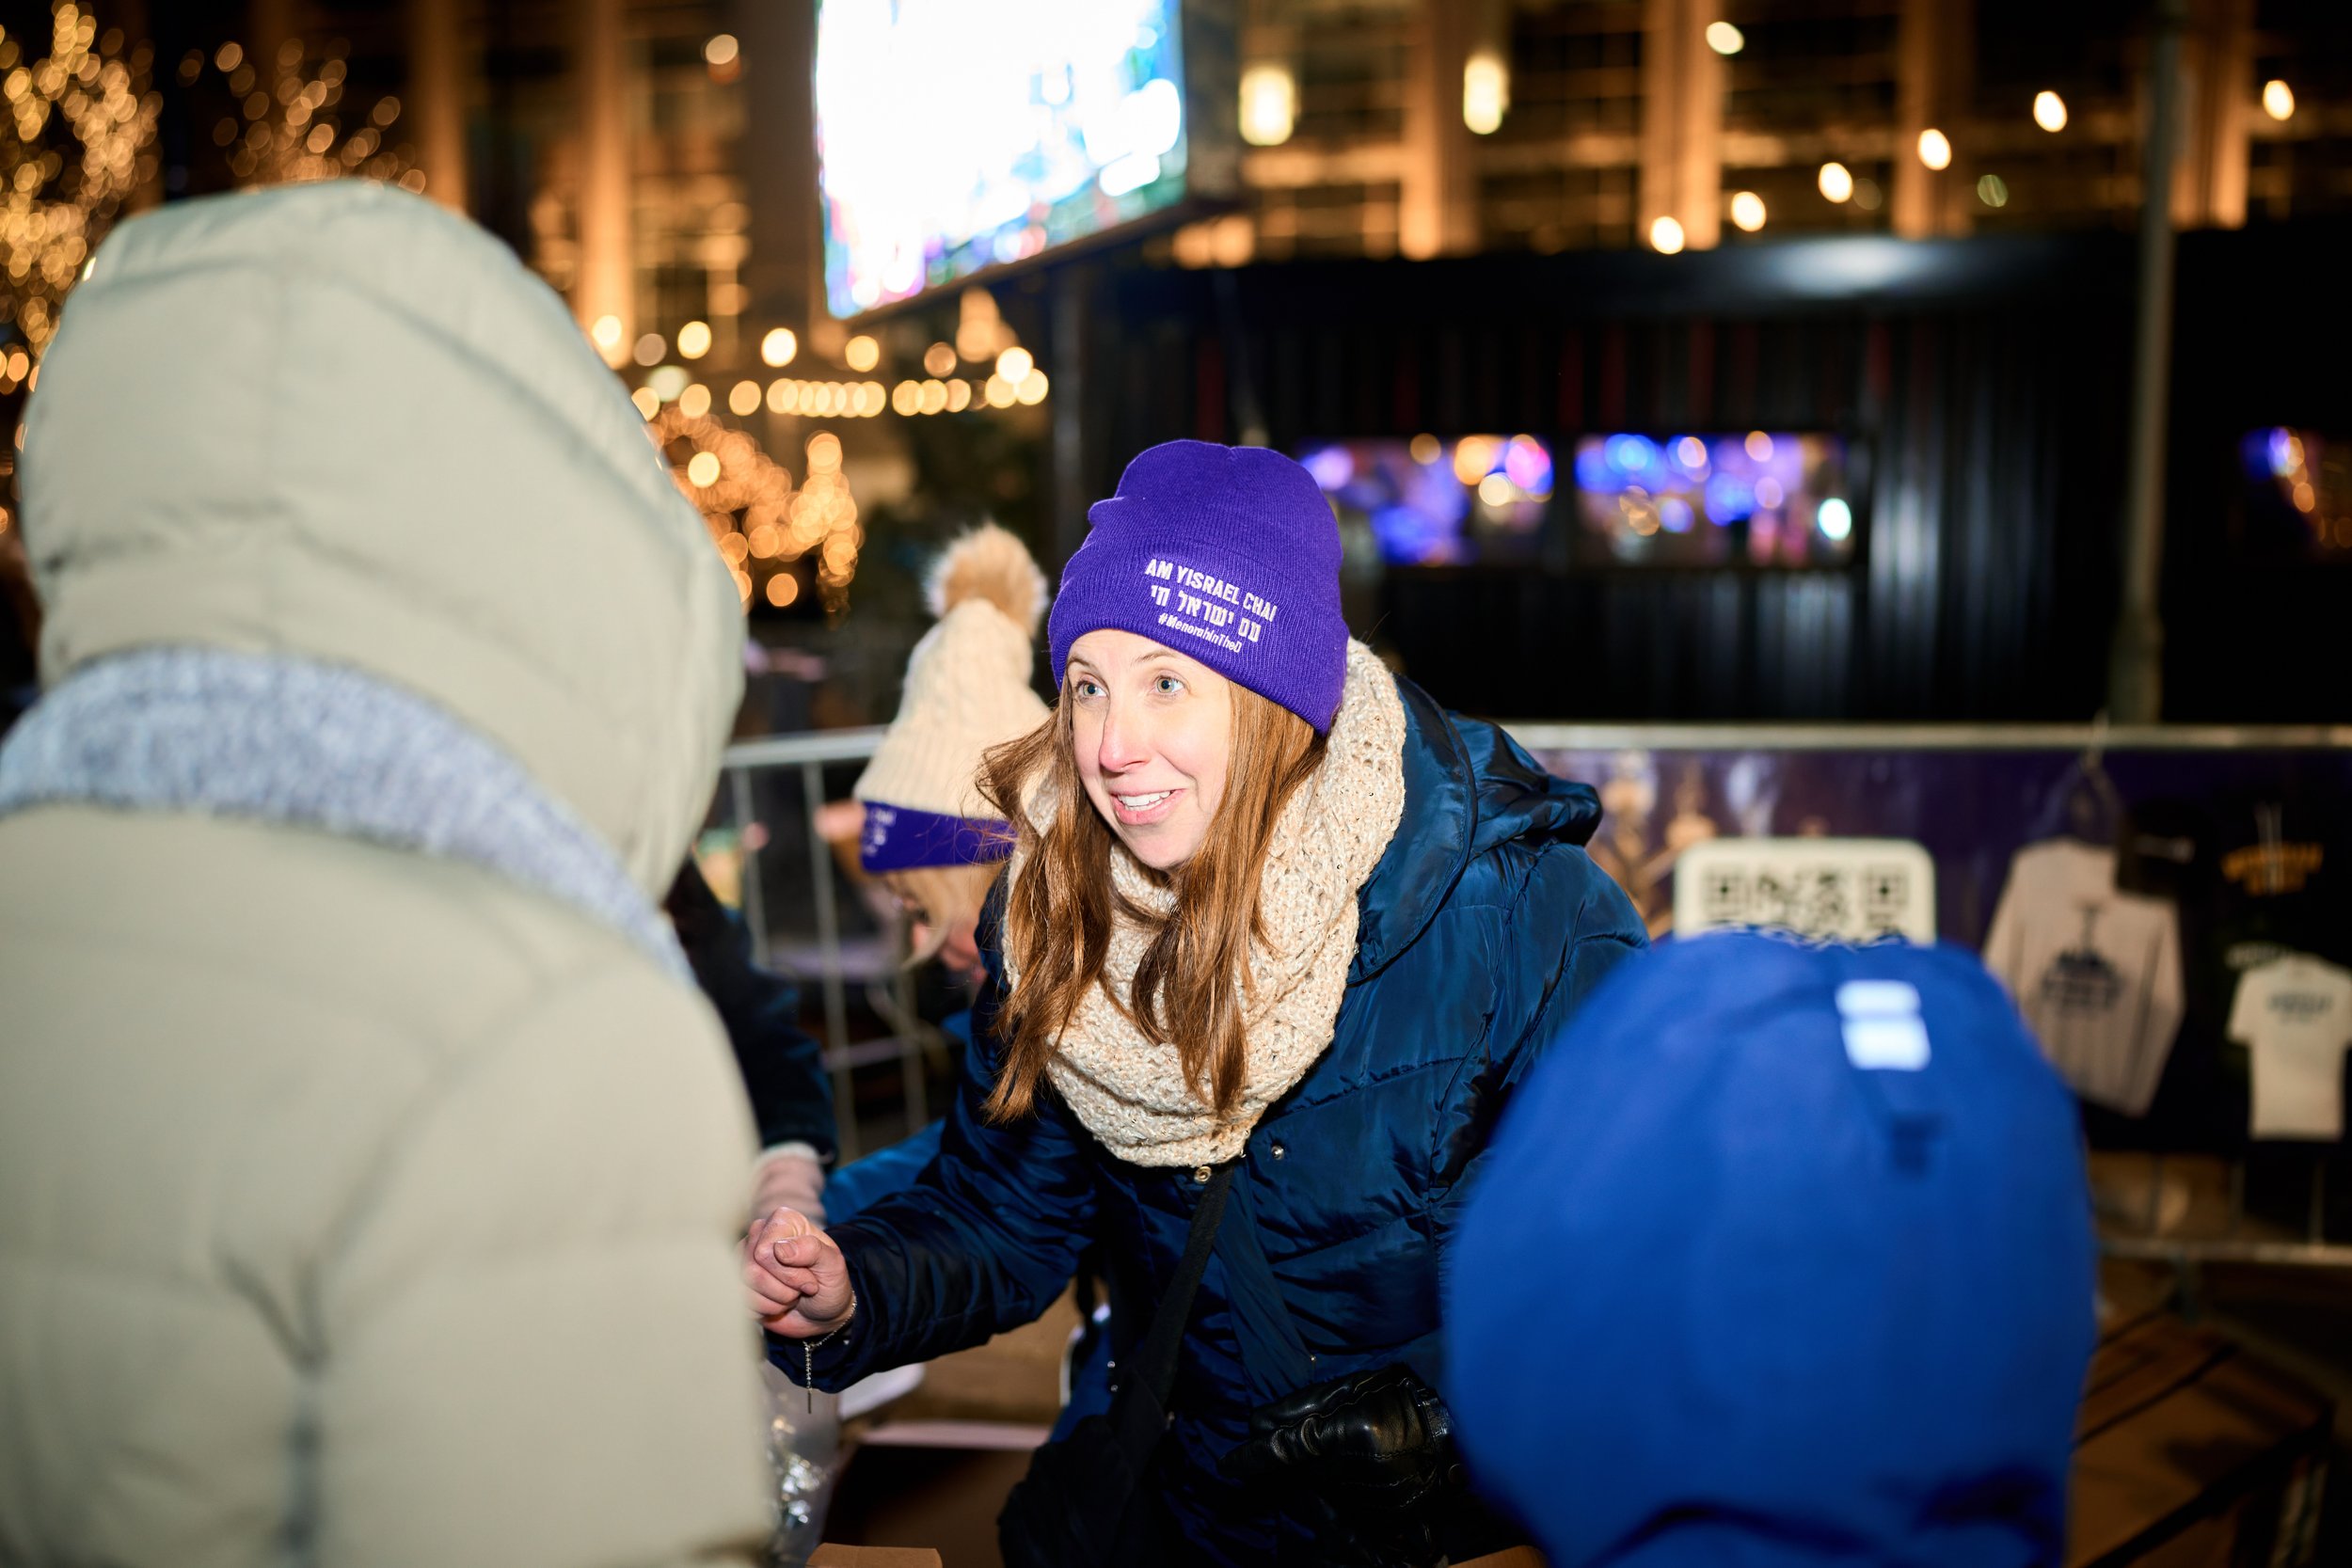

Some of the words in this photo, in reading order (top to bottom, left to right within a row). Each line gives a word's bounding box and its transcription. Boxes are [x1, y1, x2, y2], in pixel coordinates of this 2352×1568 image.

[1145, 559, 1173, 580] AM
[1176, 565, 1240, 605] YISRAEL
[1243, 592, 1278, 622] CHAI
[1151, 585, 1170, 607] חי
[1177, 590, 1234, 627] ישראל
[1158, 612, 1242, 653] #MenorahInTheD
[1238, 617, 1262, 643] עם
